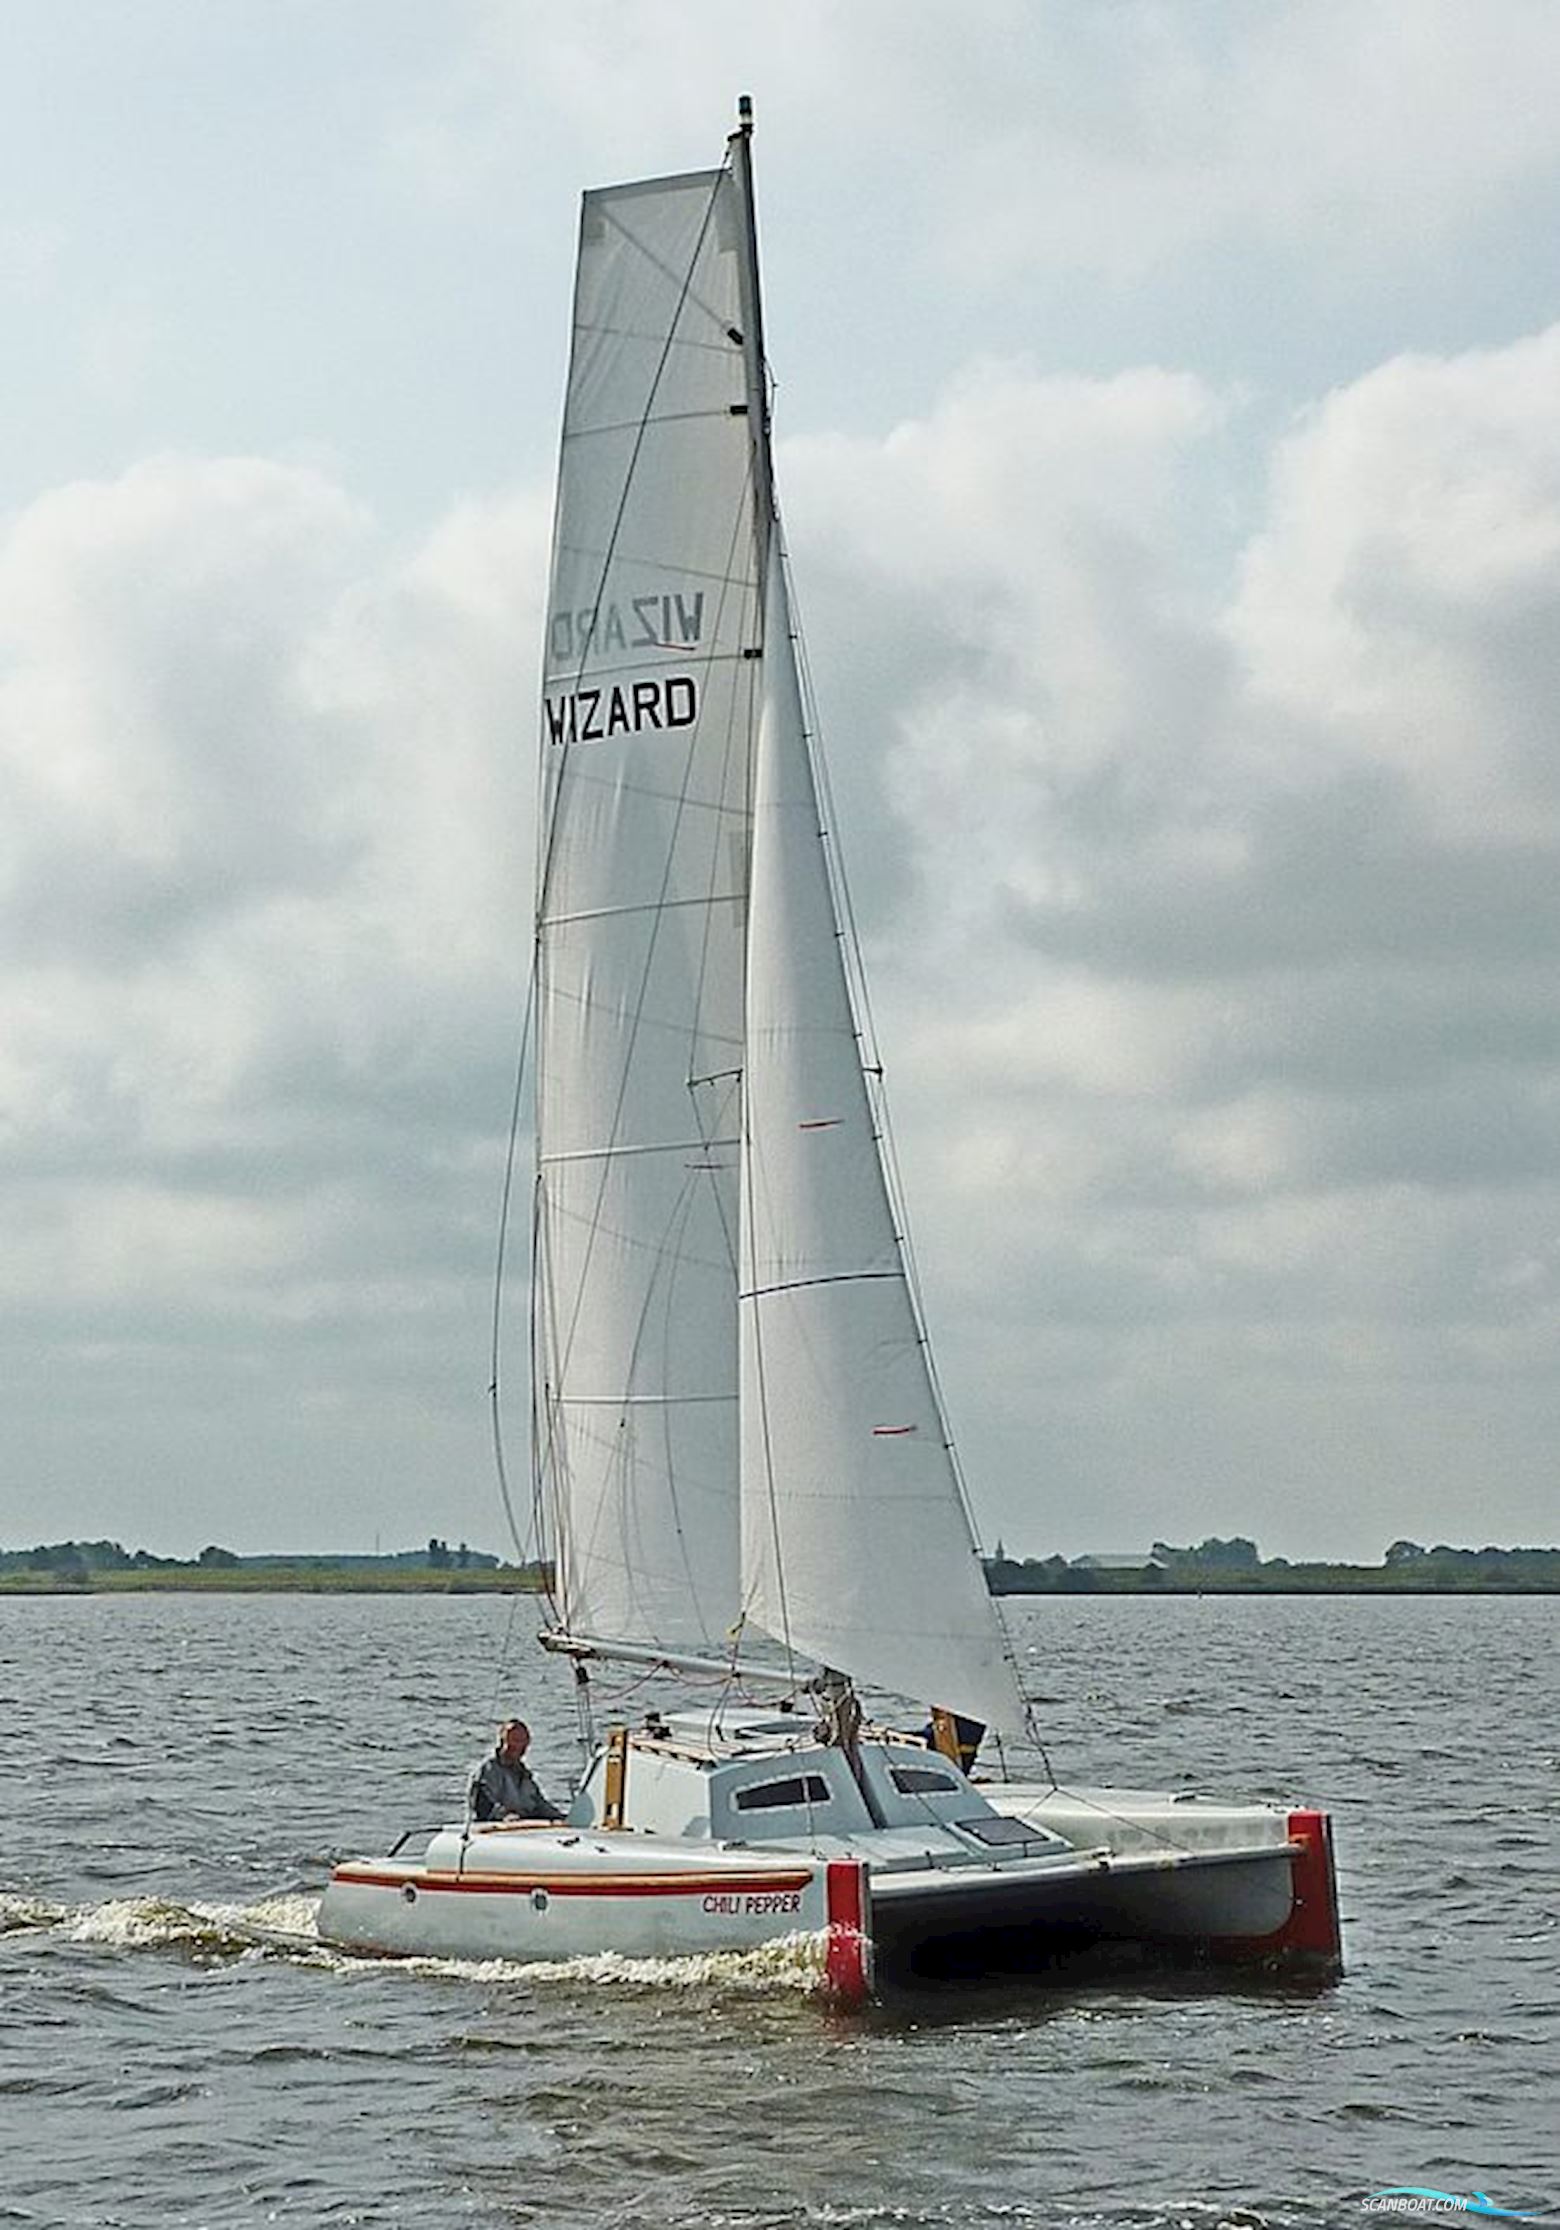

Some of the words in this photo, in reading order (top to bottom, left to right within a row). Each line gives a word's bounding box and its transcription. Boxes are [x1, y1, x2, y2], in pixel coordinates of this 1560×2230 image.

[546, 677, 697, 745] WIZARD
[703, 1896, 740, 1913] CHILI
[745, 1894, 801, 1914] PEPPER
